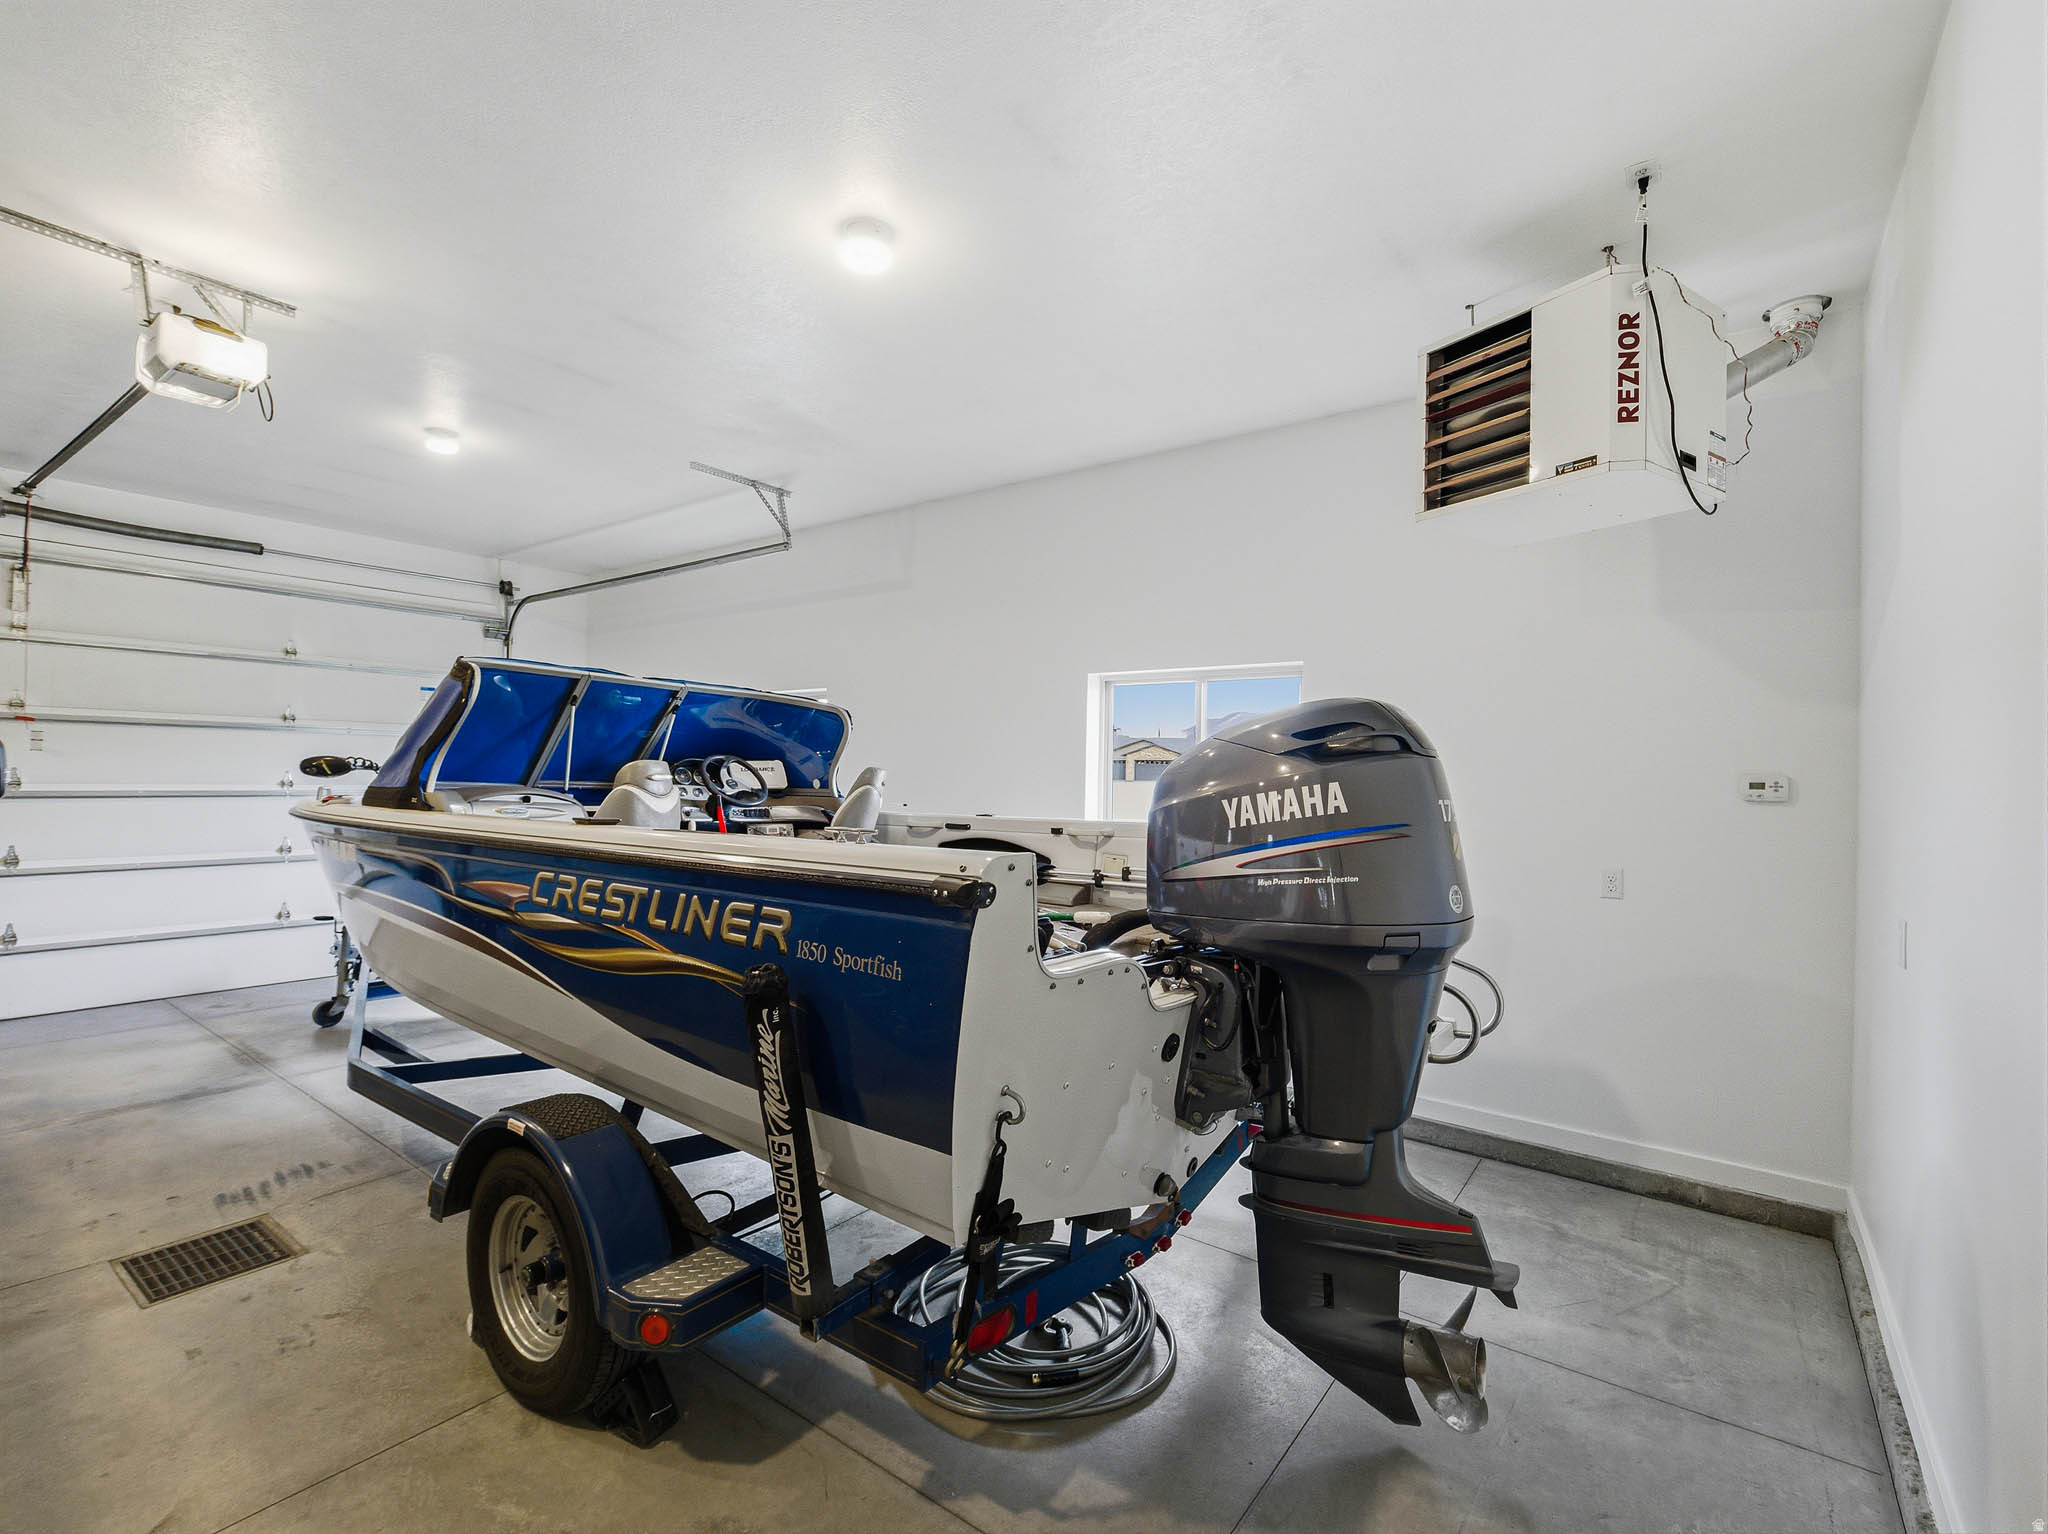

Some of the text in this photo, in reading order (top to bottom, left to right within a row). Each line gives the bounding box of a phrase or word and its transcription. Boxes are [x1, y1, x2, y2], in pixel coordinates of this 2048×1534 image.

[1617, 311, 1641, 424] REZNOR
[1221, 781, 1350, 829] YAMAHA
[531, 871, 792, 956] CRESTLINER
[1272, 878, 1303, 886] Pressure
[1303, 876, 1327, 885] Direct
[1326, 875, 1360, 884] Injection
[796, 939, 902, 982] 1850 Sportfish
[757, 1008, 791, 1136] Marine
[769, 1138, 811, 1294] ROBERTSON'S
